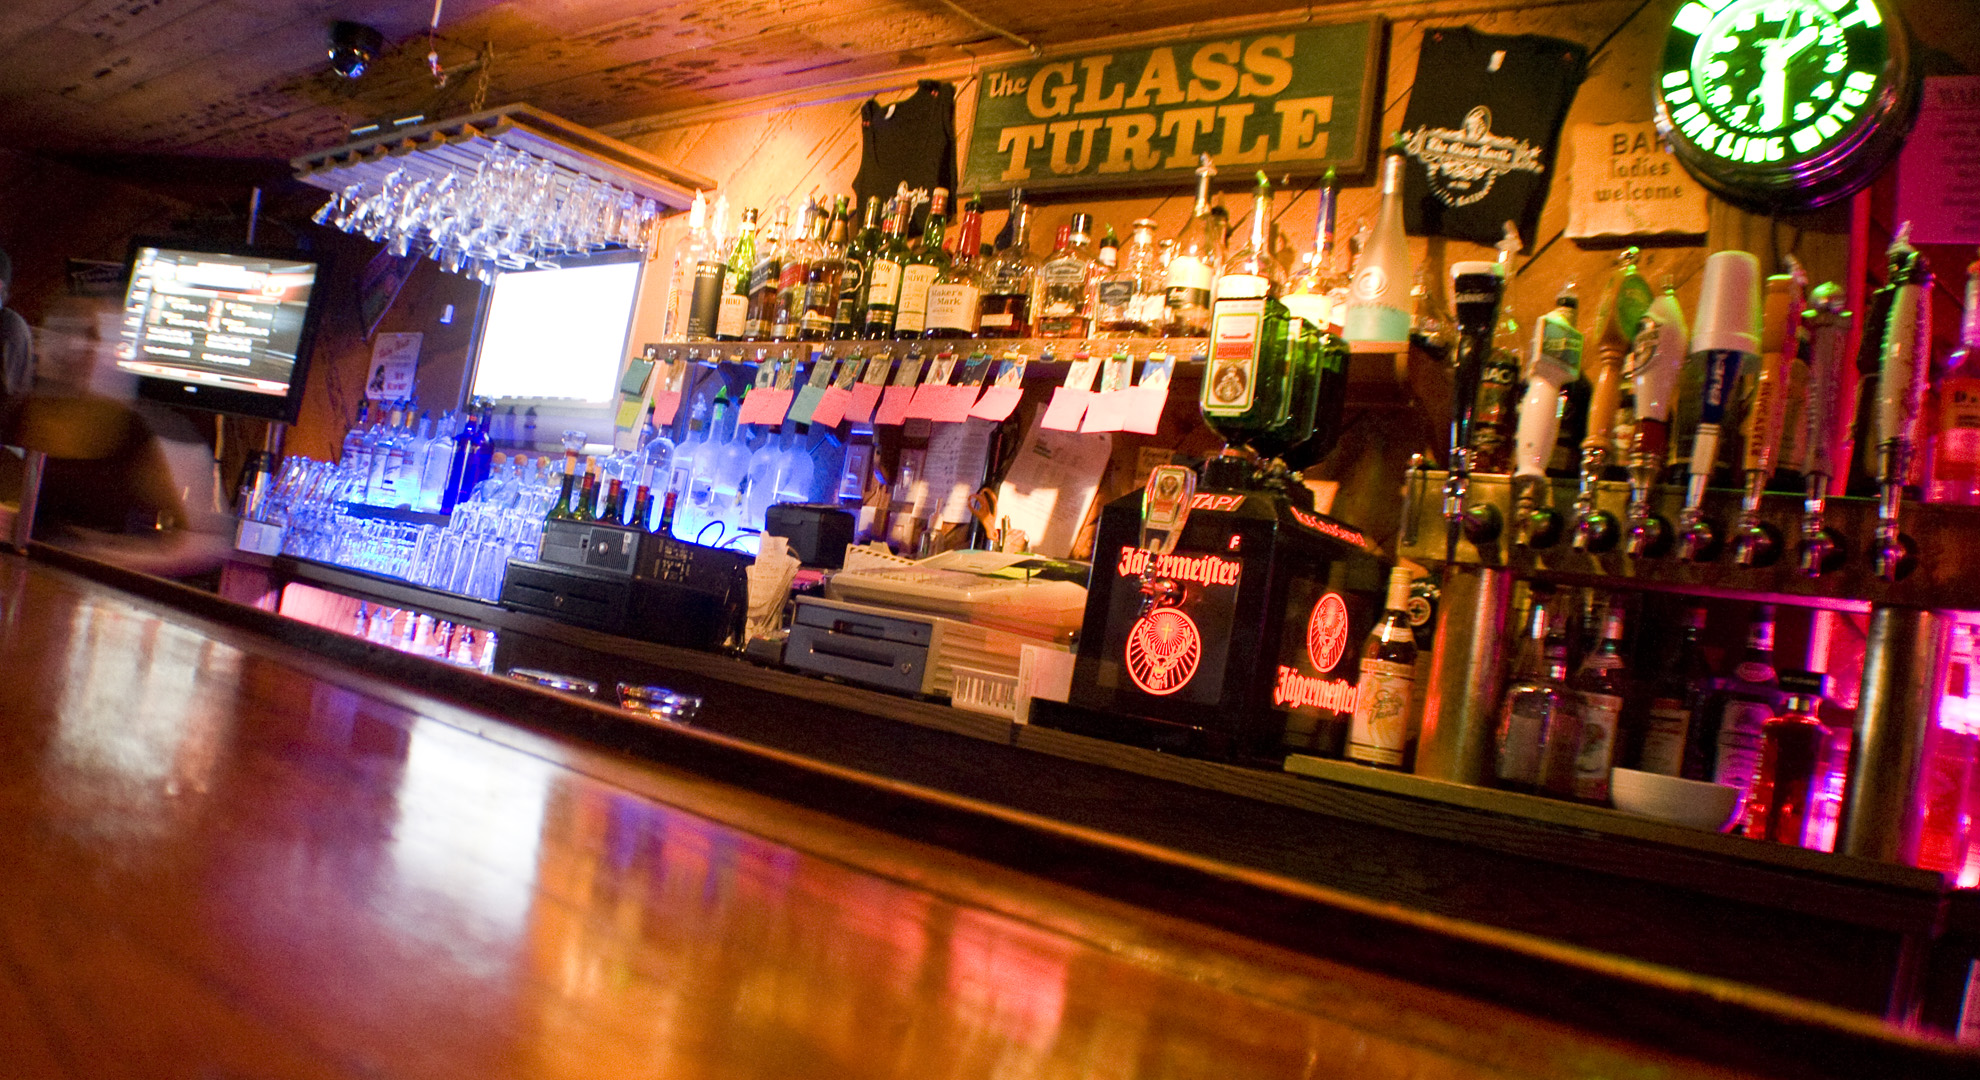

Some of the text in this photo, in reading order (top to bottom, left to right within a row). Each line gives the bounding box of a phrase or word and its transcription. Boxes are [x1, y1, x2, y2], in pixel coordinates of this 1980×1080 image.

[988, 34, 1296, 118] The GLASS
[1662, 70, 1877, 163] SPARKLING WATER
[998, 96, 1333, 182] TURTLE
[1611, 157, 1672, 178] ladies
[1594, 180, 1683, 202] welcome
[931, 288, 963, 297] Maker's
[937, 297, 961, 306] Mark
[1191, 493, 1244, 512] TAP!
